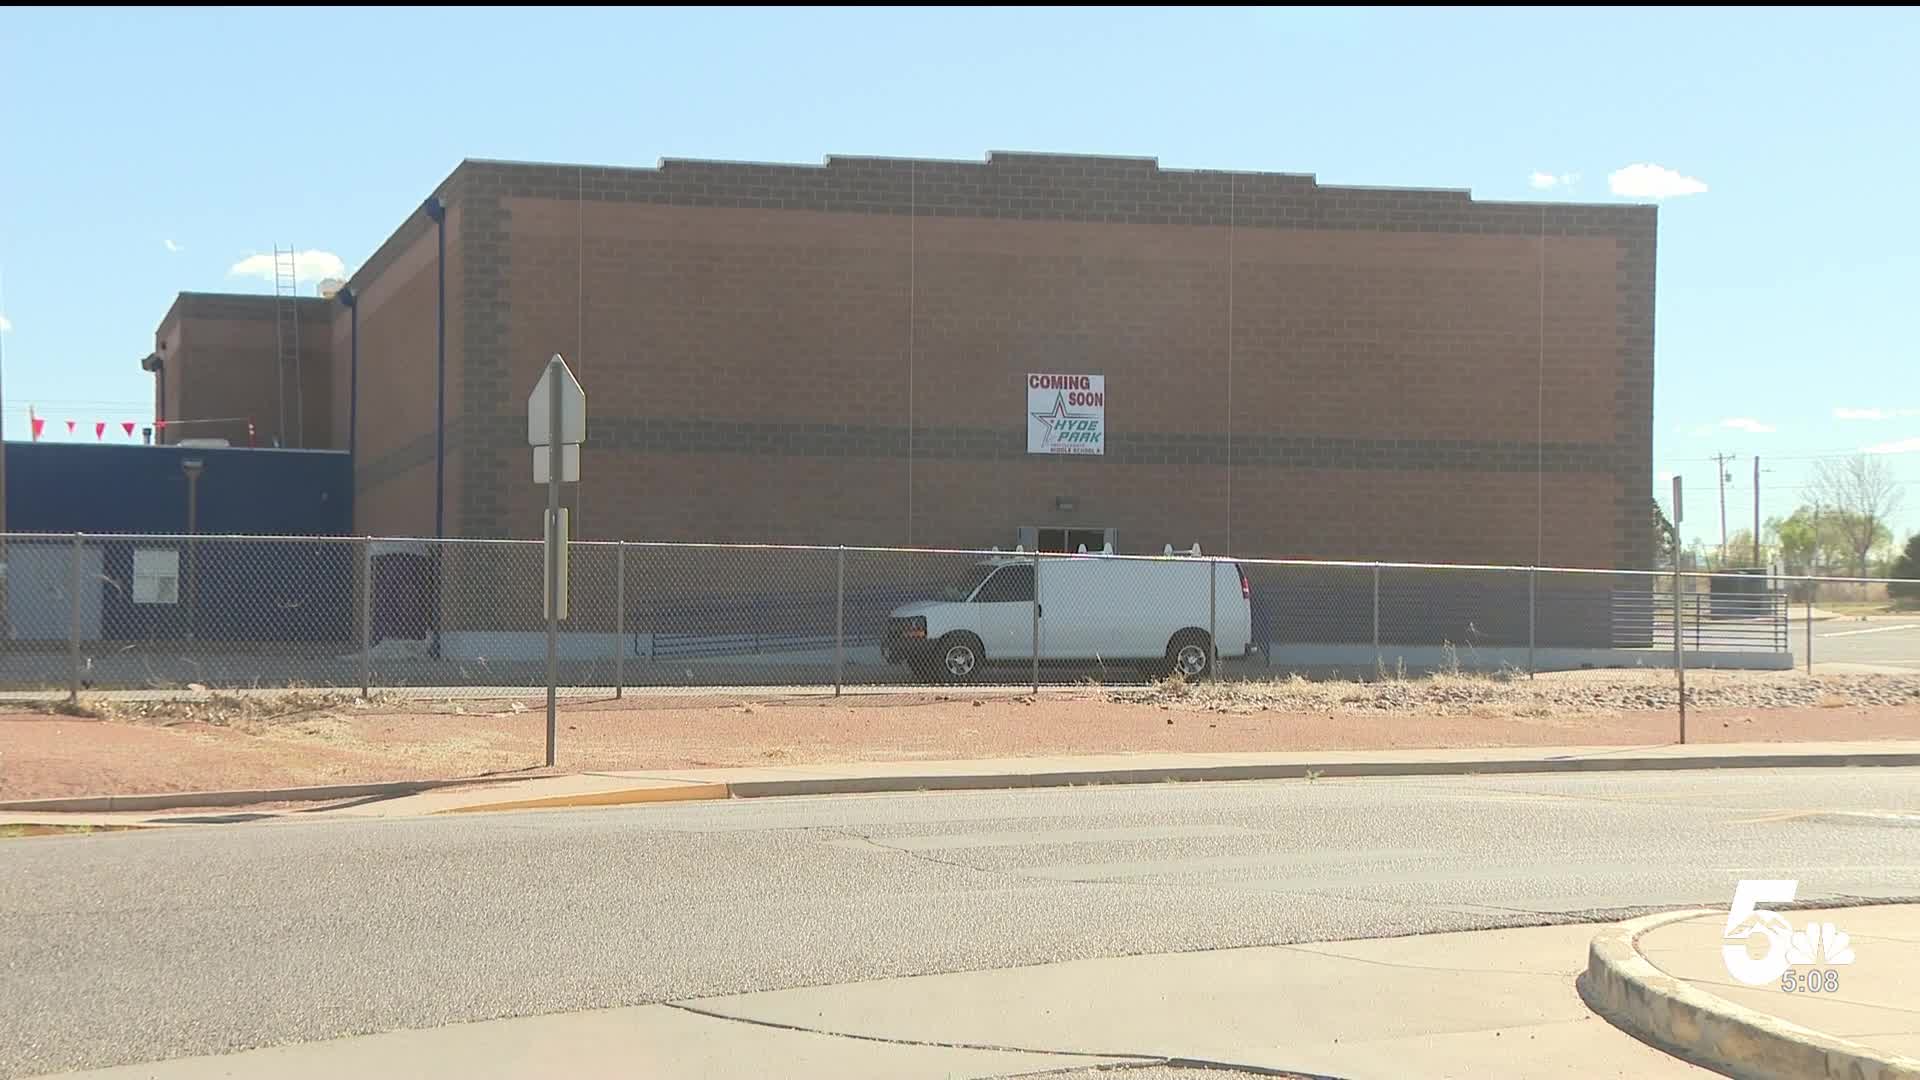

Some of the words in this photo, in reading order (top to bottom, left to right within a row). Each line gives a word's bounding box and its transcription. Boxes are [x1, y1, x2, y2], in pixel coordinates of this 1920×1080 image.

[1029, 375, 1090, 390] COMING
[1068, 391, 1103, 407] SOON
[1054, 419, 1099, 431] HYDE
[1057, 431, 1102, 443] PARK
